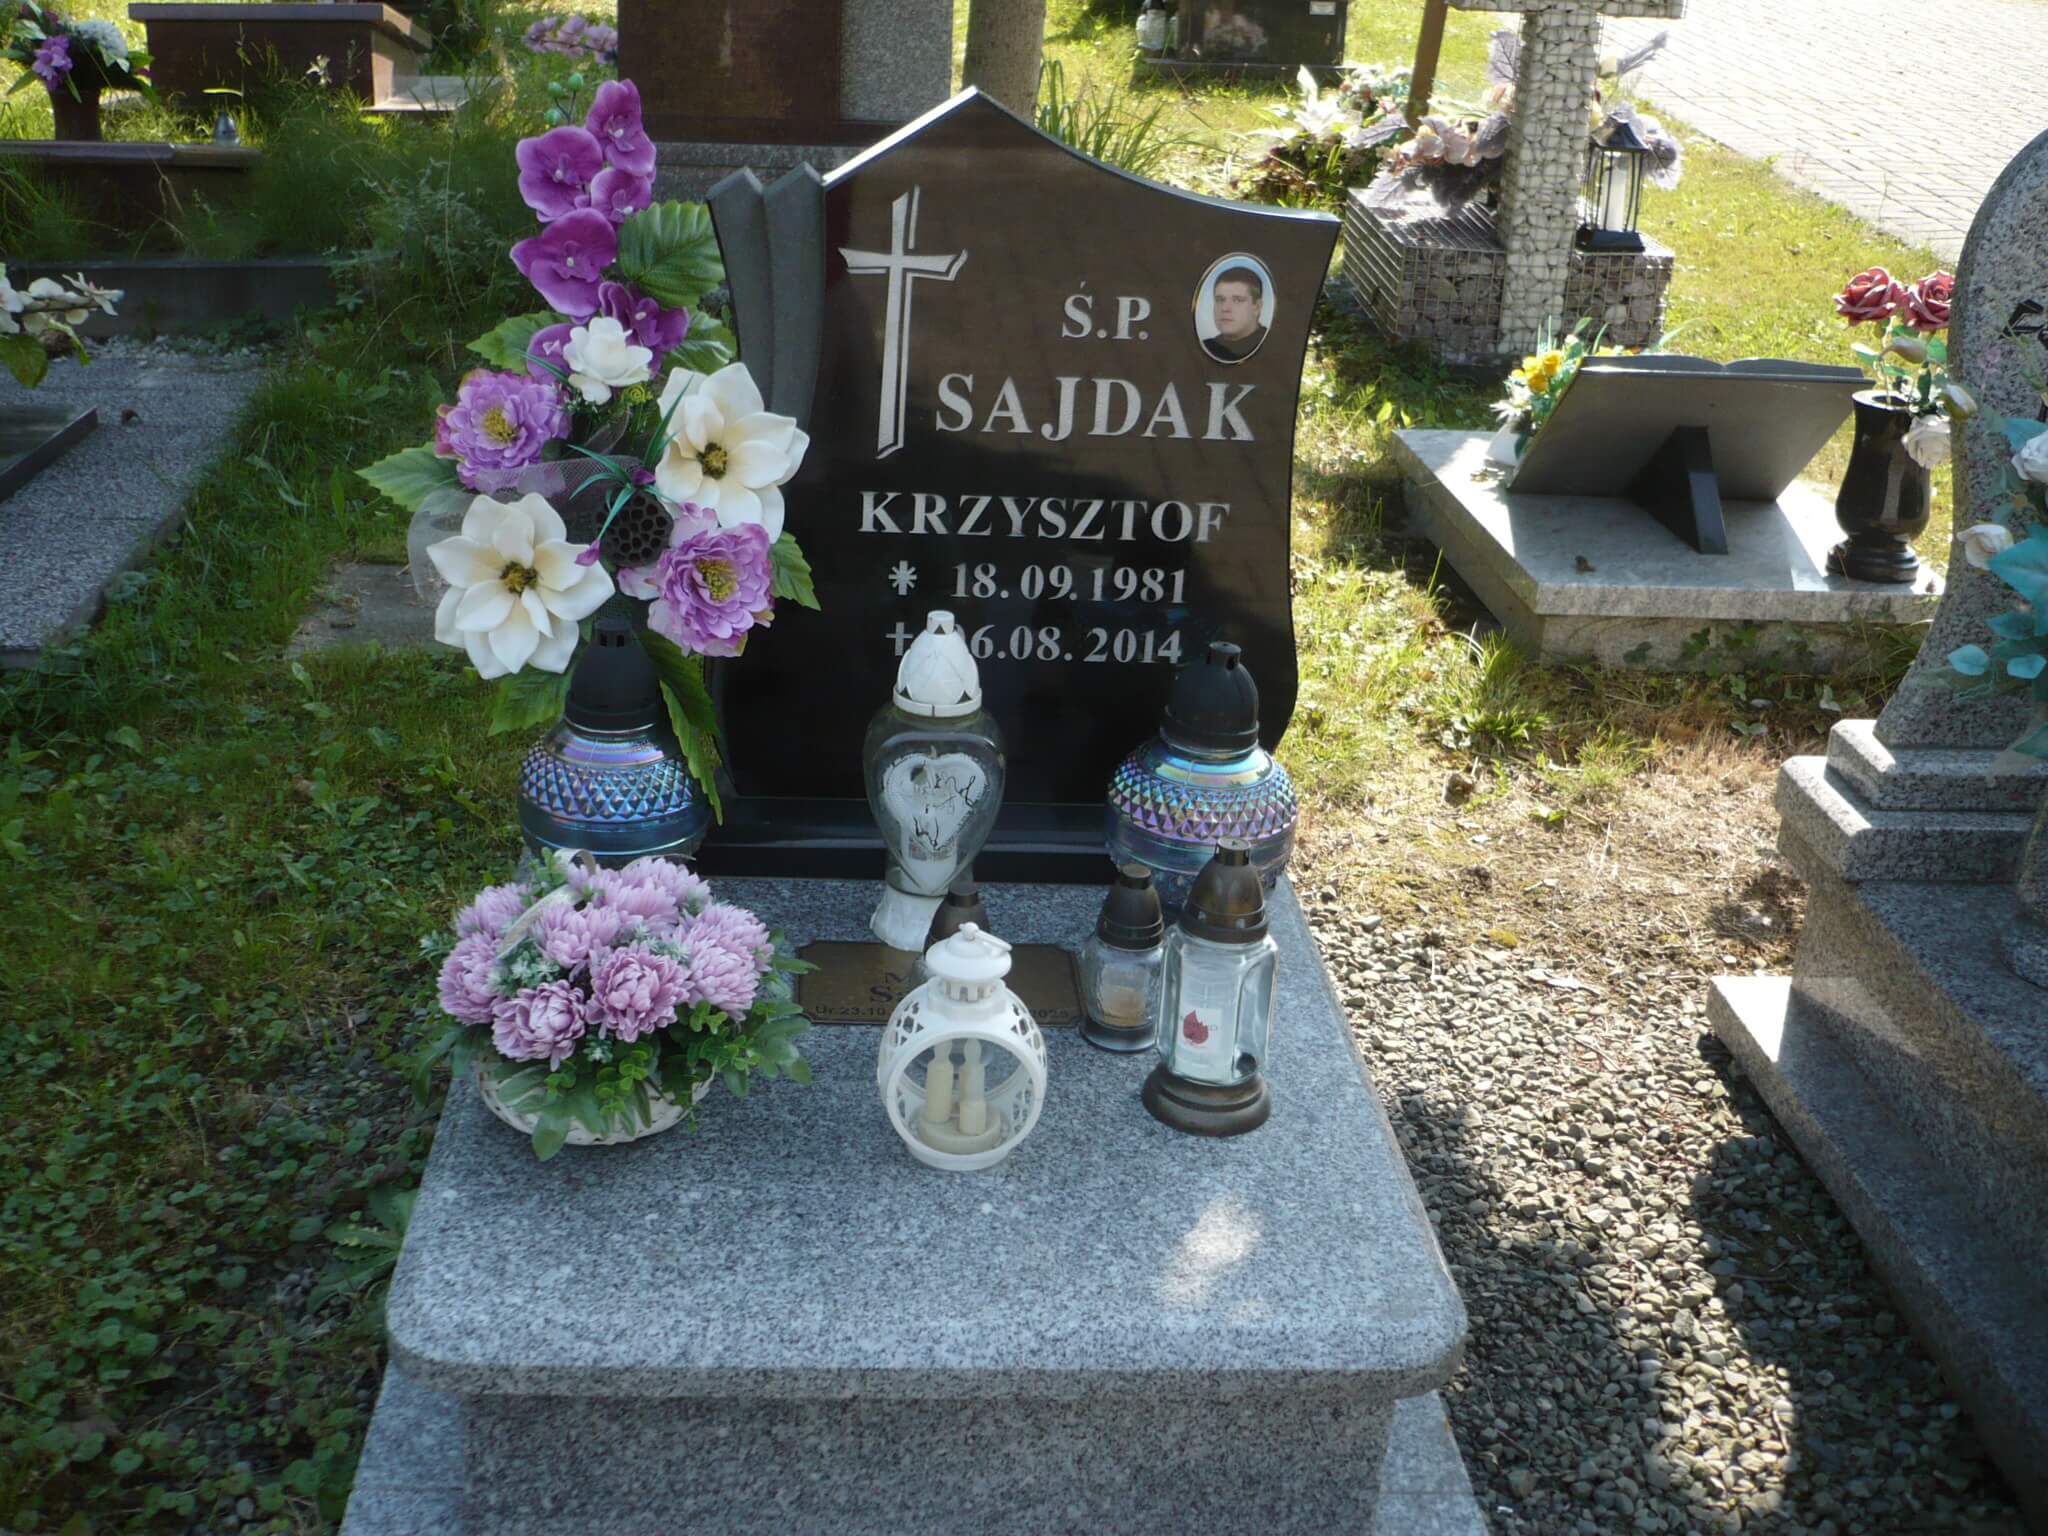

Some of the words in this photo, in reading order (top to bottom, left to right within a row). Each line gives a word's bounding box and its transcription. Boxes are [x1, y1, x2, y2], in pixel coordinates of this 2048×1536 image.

[935, 373, 1255, 441] SAJDAK
[858, 491, 1230, 543] KRZYSZTOF
[954, 623, 1182, 664] 6.08.2014
